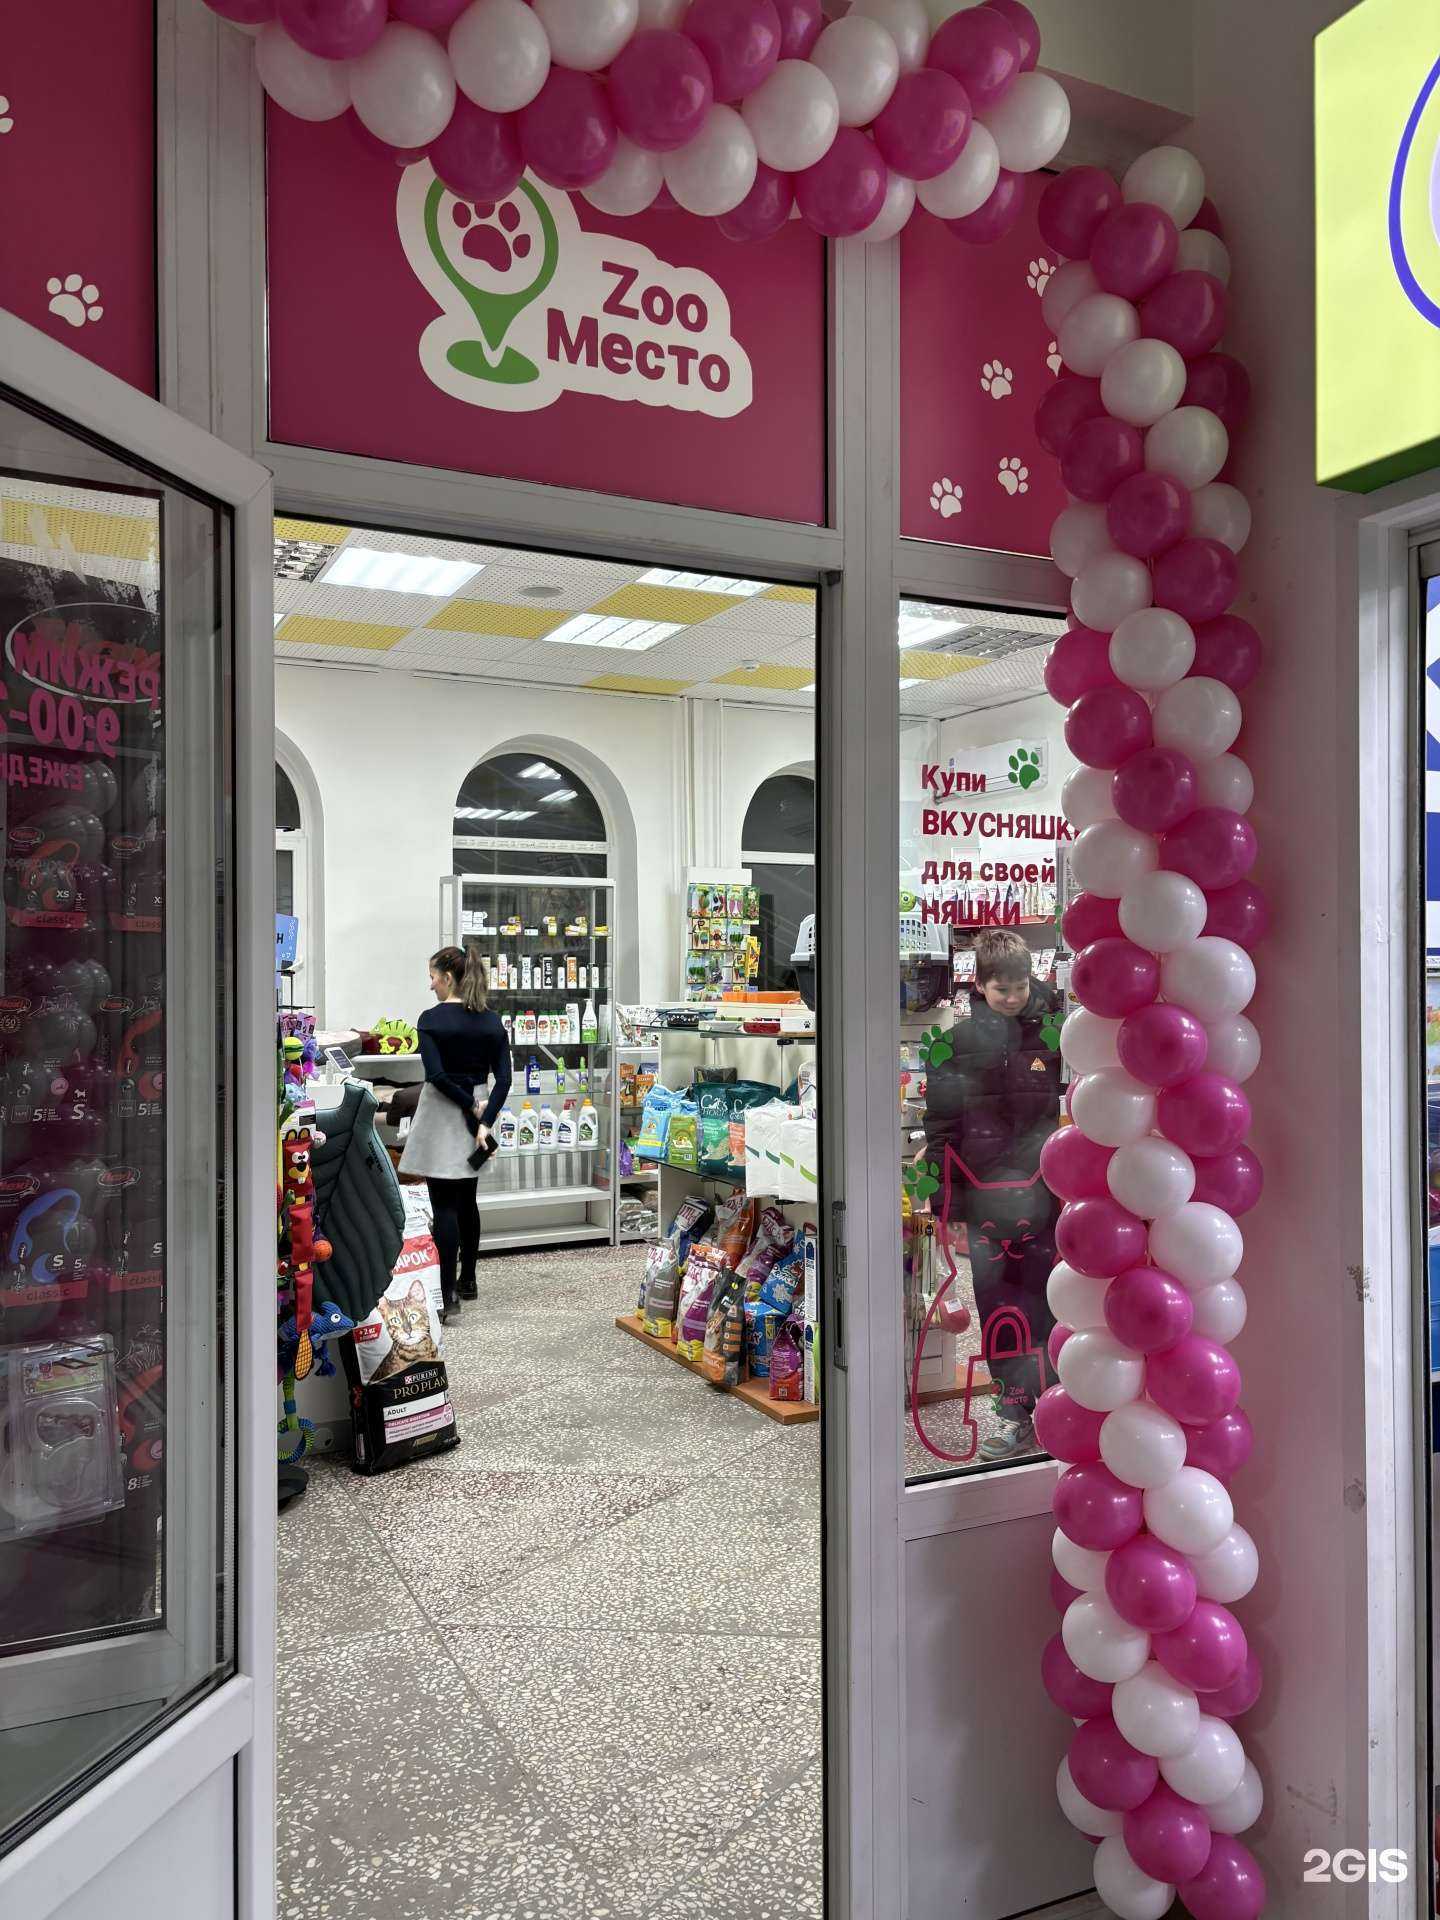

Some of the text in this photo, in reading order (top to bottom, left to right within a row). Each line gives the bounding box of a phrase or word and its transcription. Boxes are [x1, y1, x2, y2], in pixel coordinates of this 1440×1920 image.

[602, 261, 708, 333] Zoo
[547, 308, 730, 392] Место
[921, 764, 987, 798] Купи
[922, 809, 1079, 842] ВКУСНЯШК
[921, 858, 1056, 885] для своей
[921, 899, 1021, 926] НЯШКИ
[387, 1406, 407, 1416] ADULT
